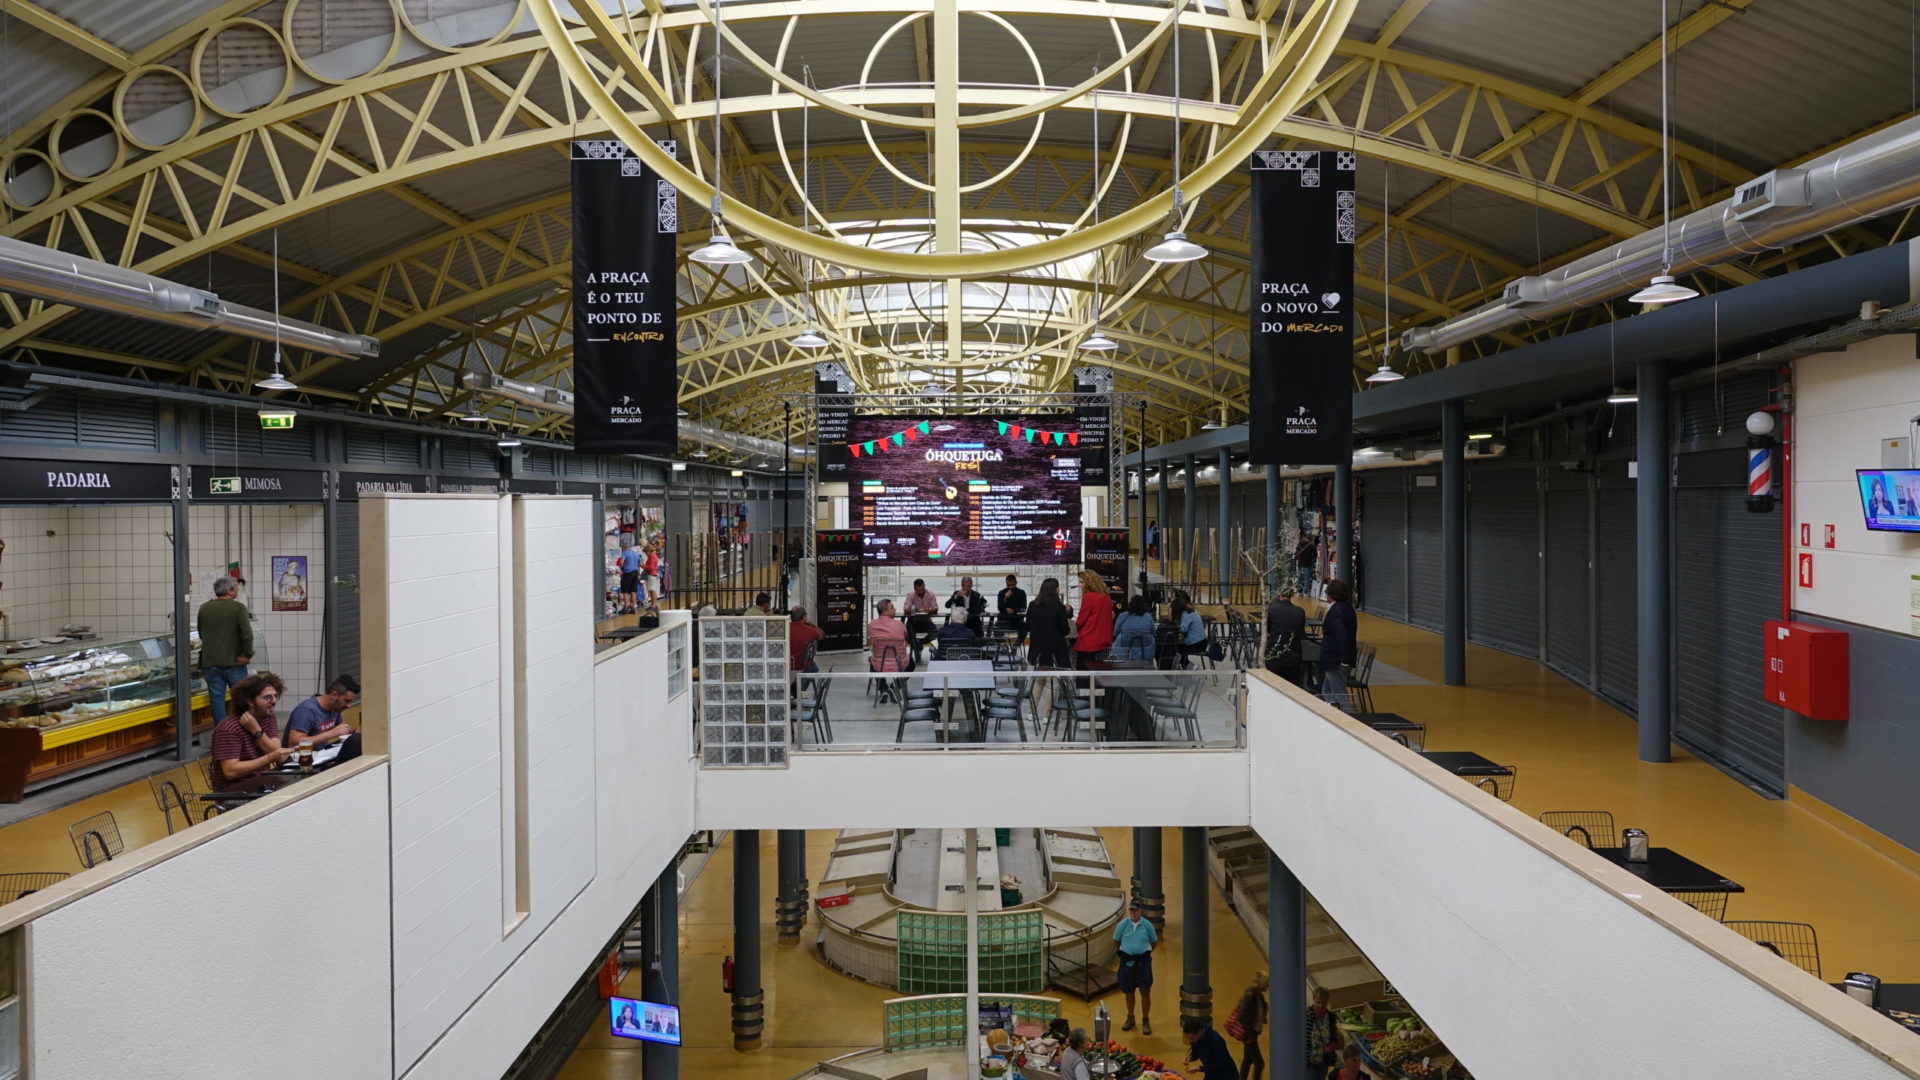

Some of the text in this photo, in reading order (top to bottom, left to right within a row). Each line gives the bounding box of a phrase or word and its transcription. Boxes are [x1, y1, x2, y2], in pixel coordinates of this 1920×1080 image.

[586, 272, 650, 286] A PRAÇA
[1261, 283, 1310, 297] PRAÇA
[587, 290, 644, 304] É O TEU
[1261, 302, 1318, 314] O NOVO
[587, 312, 662, 324] PONTO DE
[1261, 322, 1344, 333] DO MERCADO
[612, 331, 665, 343] ENCONTRO
[610, 406, 642, 415] PRAÇA
[1286, 417, 1317, 426] PRAÇA
[925, 448, 1002, 463] ÓHQUETUGA
[47, 472, 111, 488] PADARIA
[244, 477, 282, 490] MIMOSA
[356, 481, 413, 493] PADARIA DA LÍDIA
